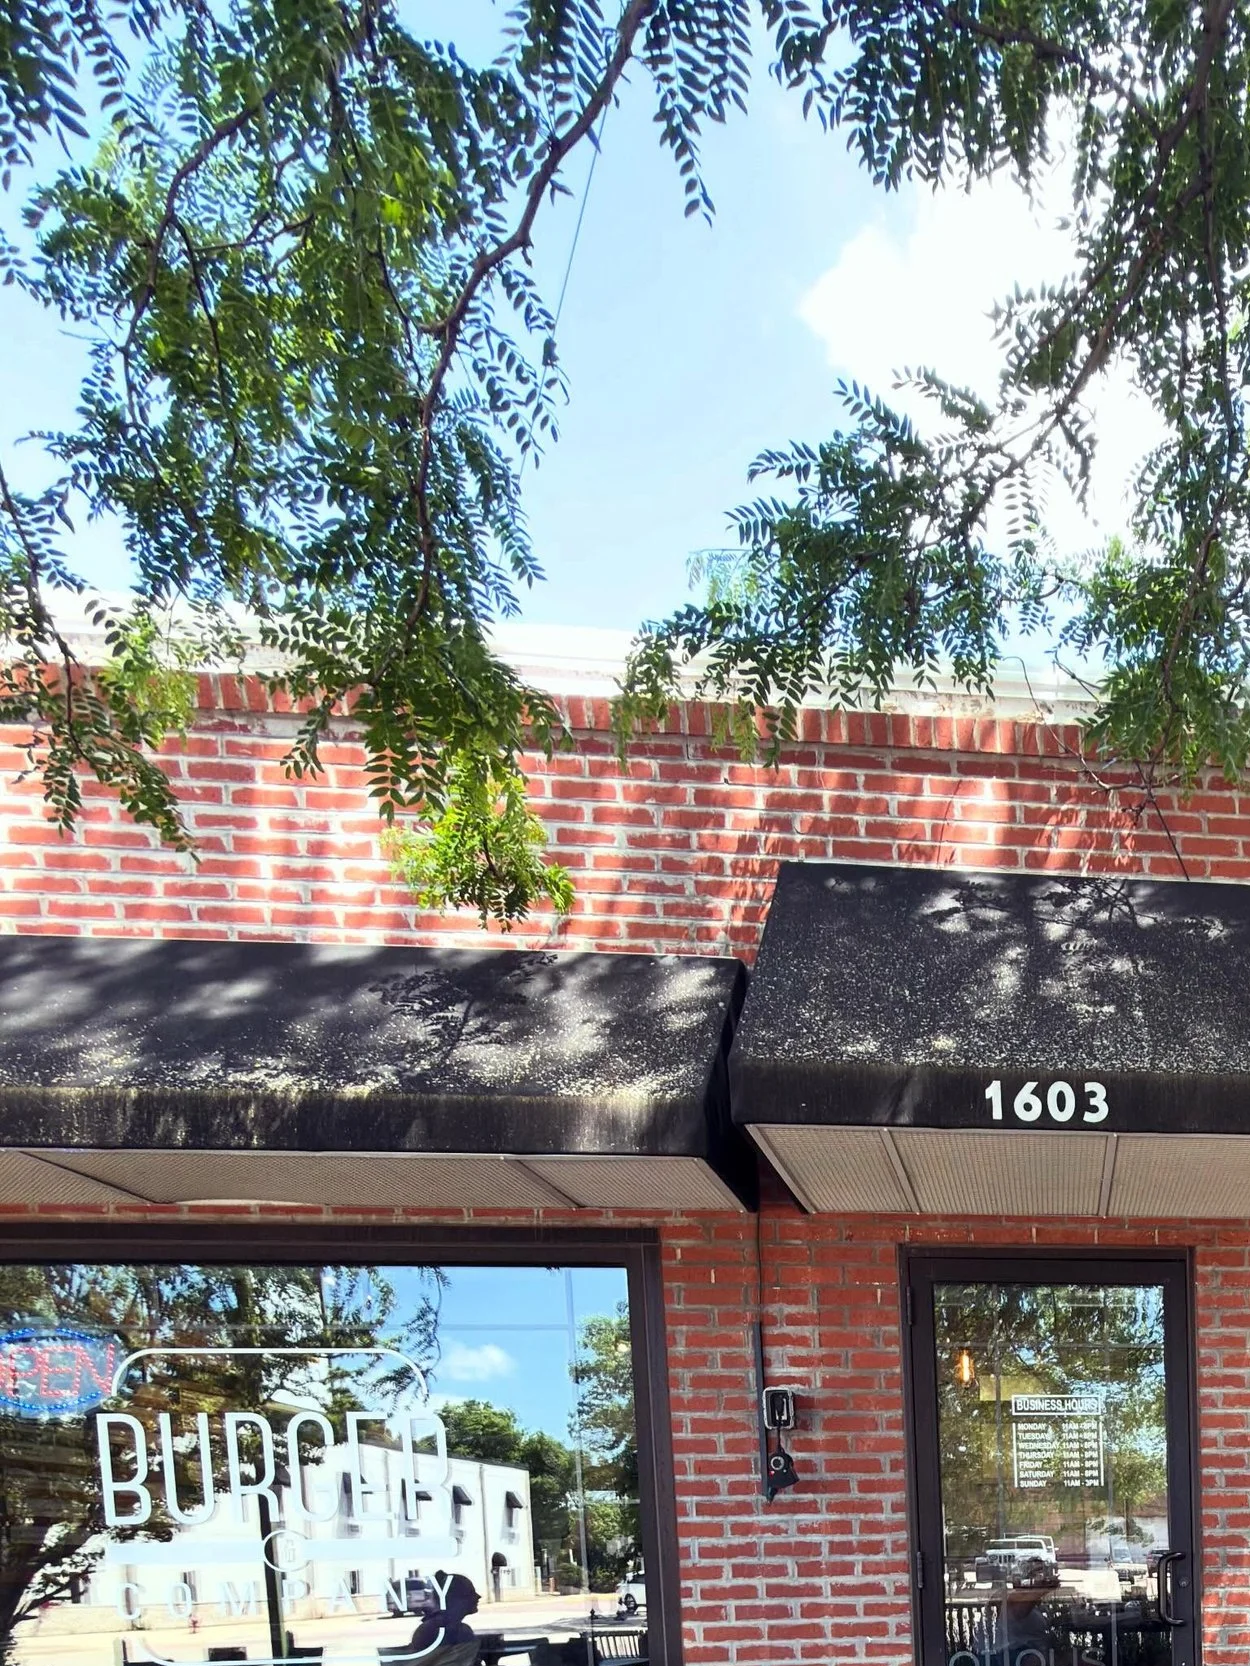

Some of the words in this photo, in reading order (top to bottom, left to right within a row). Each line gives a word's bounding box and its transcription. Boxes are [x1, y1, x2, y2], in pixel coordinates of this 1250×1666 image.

[984, 1079, 1109, 1123] 1603
[0, 1343, 115, 1397] PEN
[1016, 1398, 1062, 1411] BUSINESS
[1064, 1398, 1098, 1411] HOURS
[1062, 1422, 1079, 1430] 11AM
[1062, 1432, 1079, 1440] 11AM
[1063, 1442, 1080, 1450] 11AM
[1063, 1451, 1080, 1459] 11AM
[1063, 1460, 1080, 1468] 11AM
[96, 1411, 460, 1526] BURGER
[1019, 1470, 1055, 1478] SATURDAY
[1063, 1470, 1080, 1478] 11AM
[1064, 1479, 1080, 1487] 11AM
[116, 1574, 455, 1621] COMPANY
